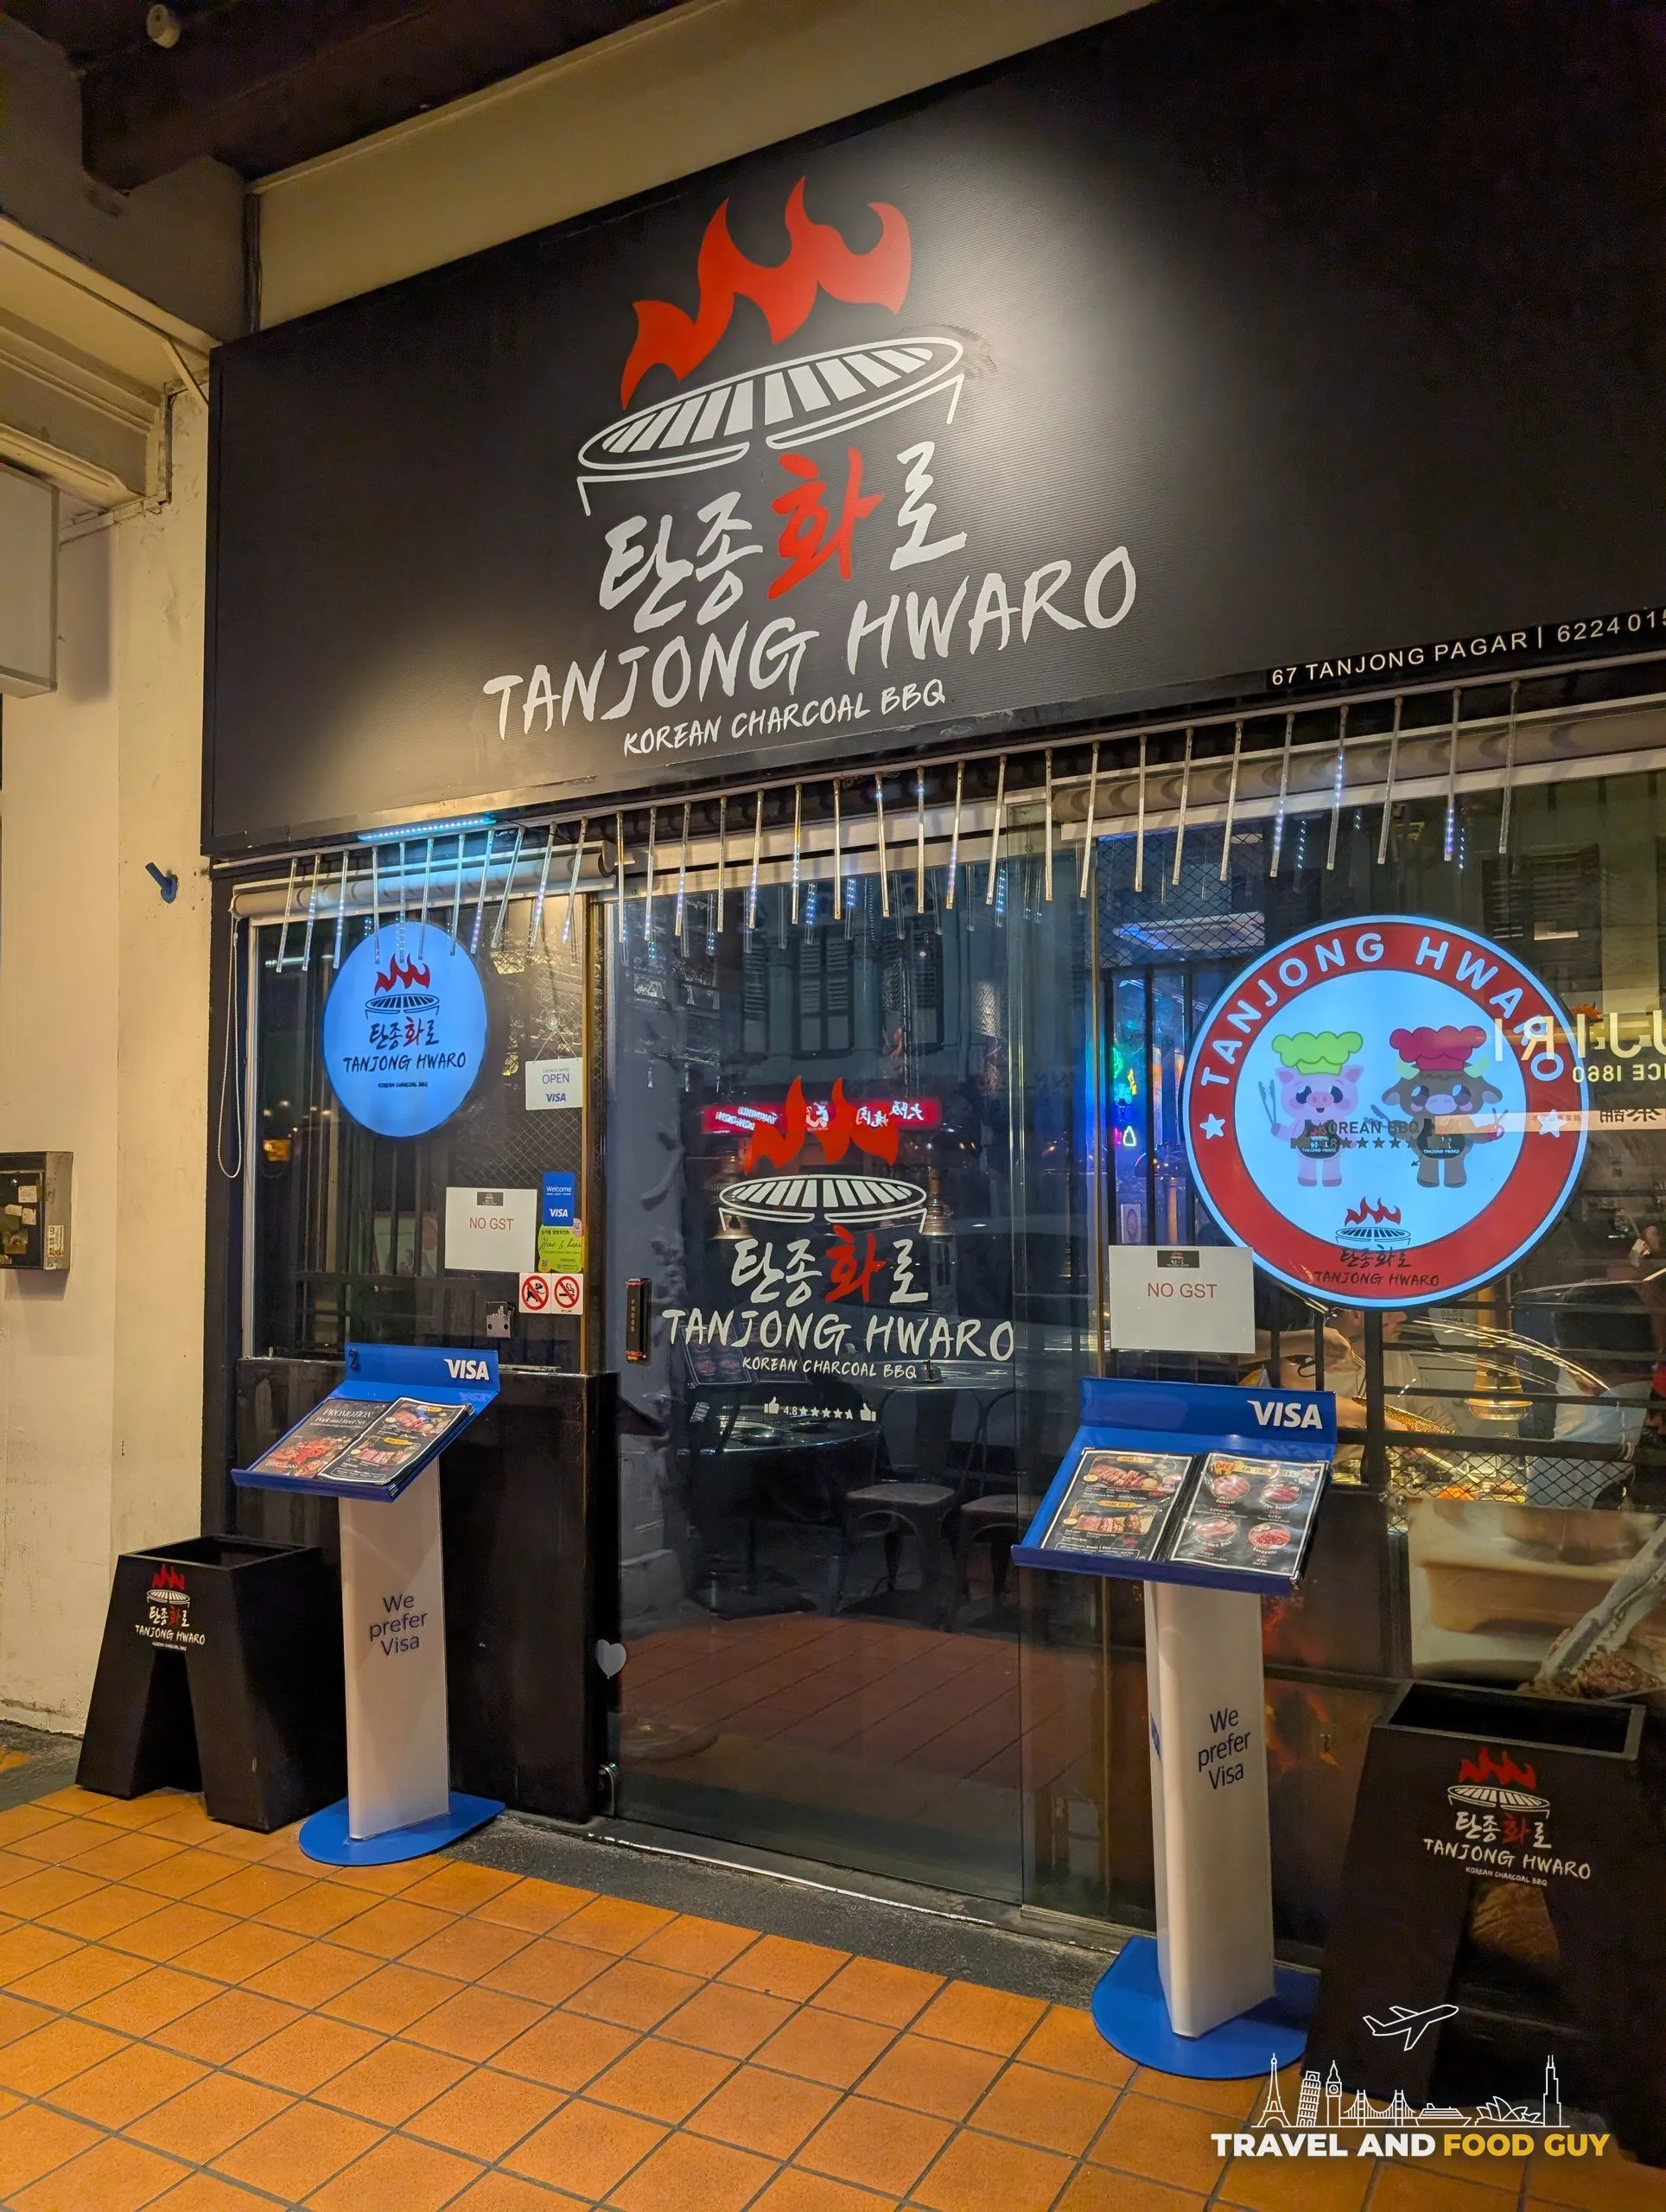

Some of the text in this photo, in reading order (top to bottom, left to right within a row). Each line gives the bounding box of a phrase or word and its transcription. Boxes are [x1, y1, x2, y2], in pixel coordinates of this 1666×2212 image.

[484, 546, 1138, 741] TANJONG HWARO
[1271, 668, 1298, 687] 67
[1306, 648, 1425, 682] TANJONG
[1434, 632, 1529, 663] PAGAR
[1557, 617, 1621, 644] 6224
[624, 677, 947, 757] KOREAN CHARCOAL BBQ
[1200, 931, 1565, 1088] TANJONG HWARO
[343, 1052, 467, 1073] TANJONG HWARO
[542, 1073, 570, 1084] OPEN
[544, 1093, 567, 1103] VISA
[1319, 1120, 1421, 1135] KOREAN BBQ
[469, 1217, 514, 1230] NO GST
[549, 1208, 569, 1217] VISA
[1313, 1271, 1440, 1287] TANJONG HWARO
[1147, 1282, 1218, 1299] NO GST
[662, 1307, 1014, 1361] TANJONG HWARO
[443, 1358, 490, 1381] VISA
[742, 1356, 918, 1380] KOREAN CHARCOAL BBQ
[783, 1405, 798, 1415] 4.8
[1247, 1400, 1323, 1429] VISA
[383, 1593, 415, 1614] We
[135, 1624, 206, 1645] TANJONG HWARO
[369, 1611, 428, 1642] prefer
[380, 1634, 420, 1656] Visa
[1210, 1707, 1238, 1733] We
[1198, 1732, 1251, 1772] prefer
[1209, 1763, 1244, 1790] Visa
[1423, 1838, 1591, 1879] TANJONG HWARO
[1466, 1866, 1548, 1887] KOREAN CHARCOAL BBQ
